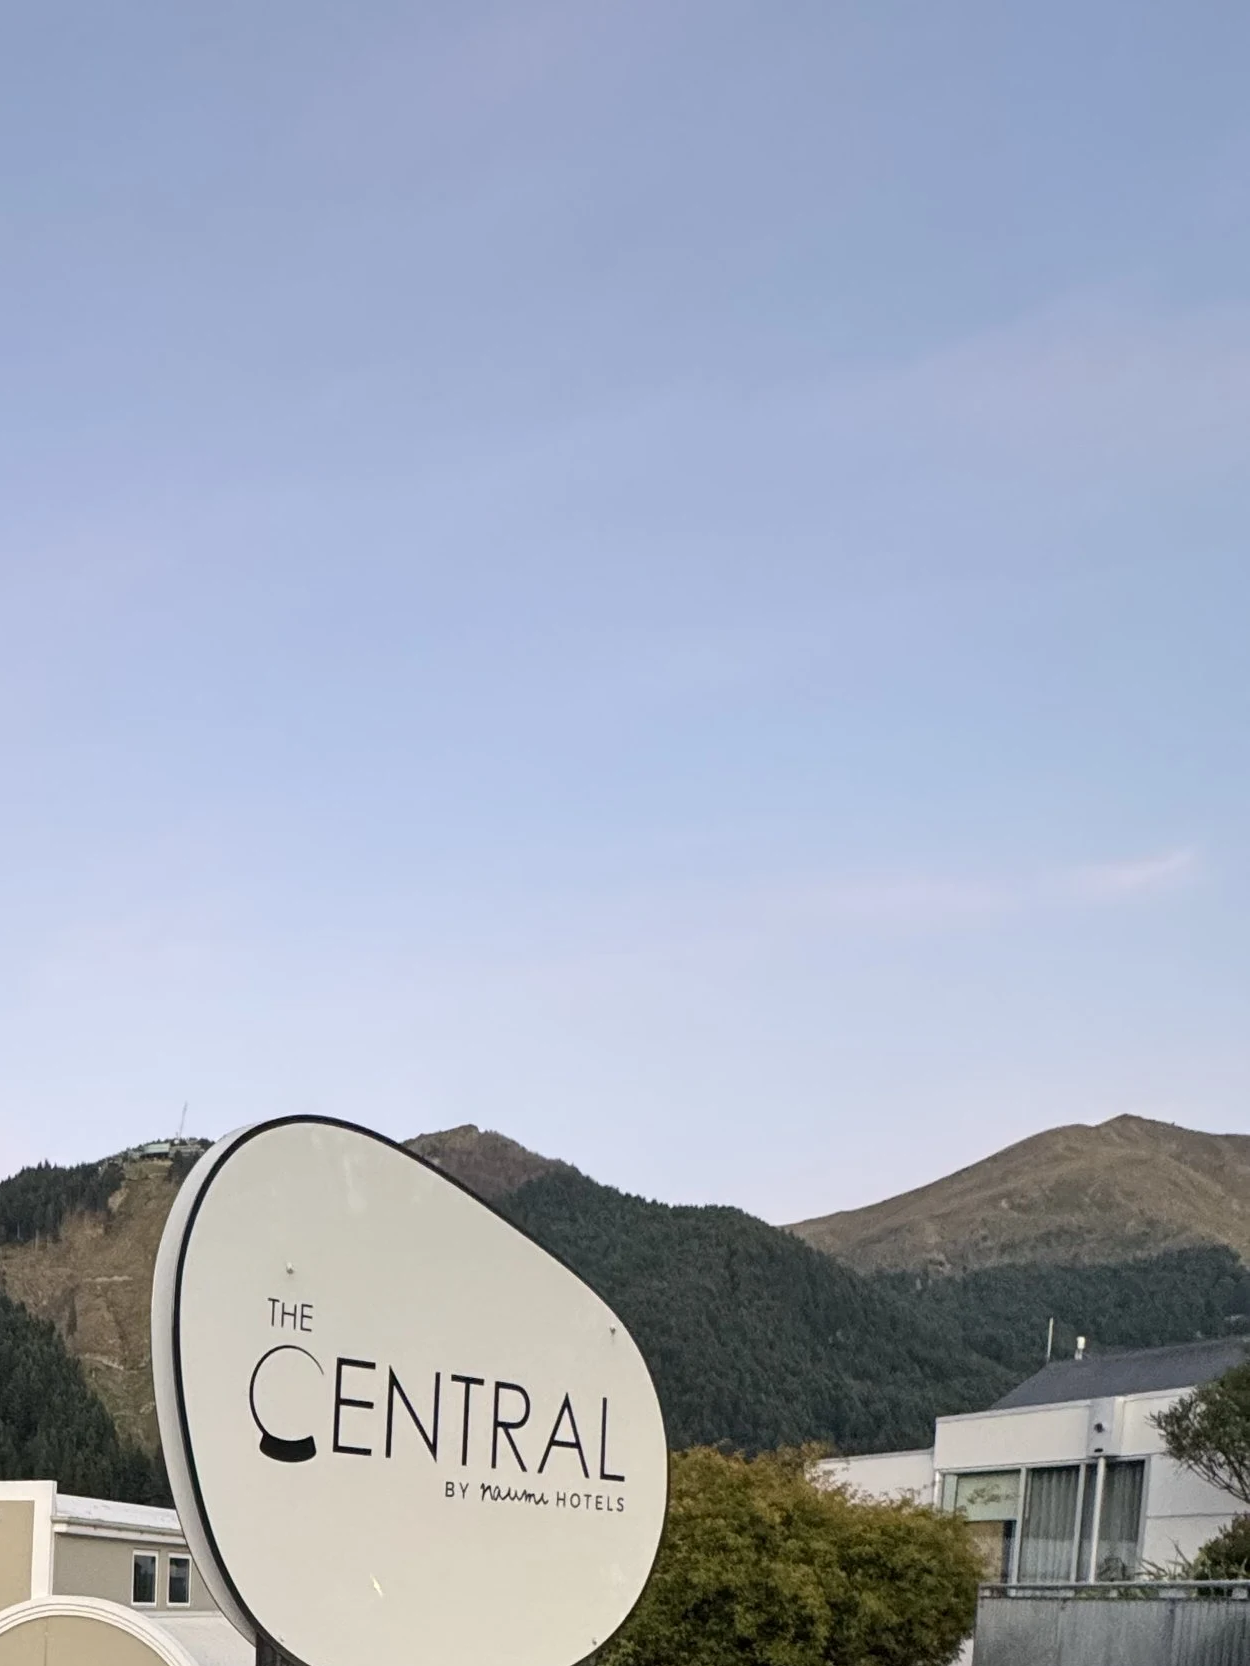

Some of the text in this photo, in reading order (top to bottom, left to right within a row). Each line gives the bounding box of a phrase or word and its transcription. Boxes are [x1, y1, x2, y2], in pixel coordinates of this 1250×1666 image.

[267, 1297, 314, 1333] THE
[249, 1344, 626, 1483] CENTRAL
[444, 1481, 470, 1499] BY
[555, 1491, 625, 1513] HOTELS
